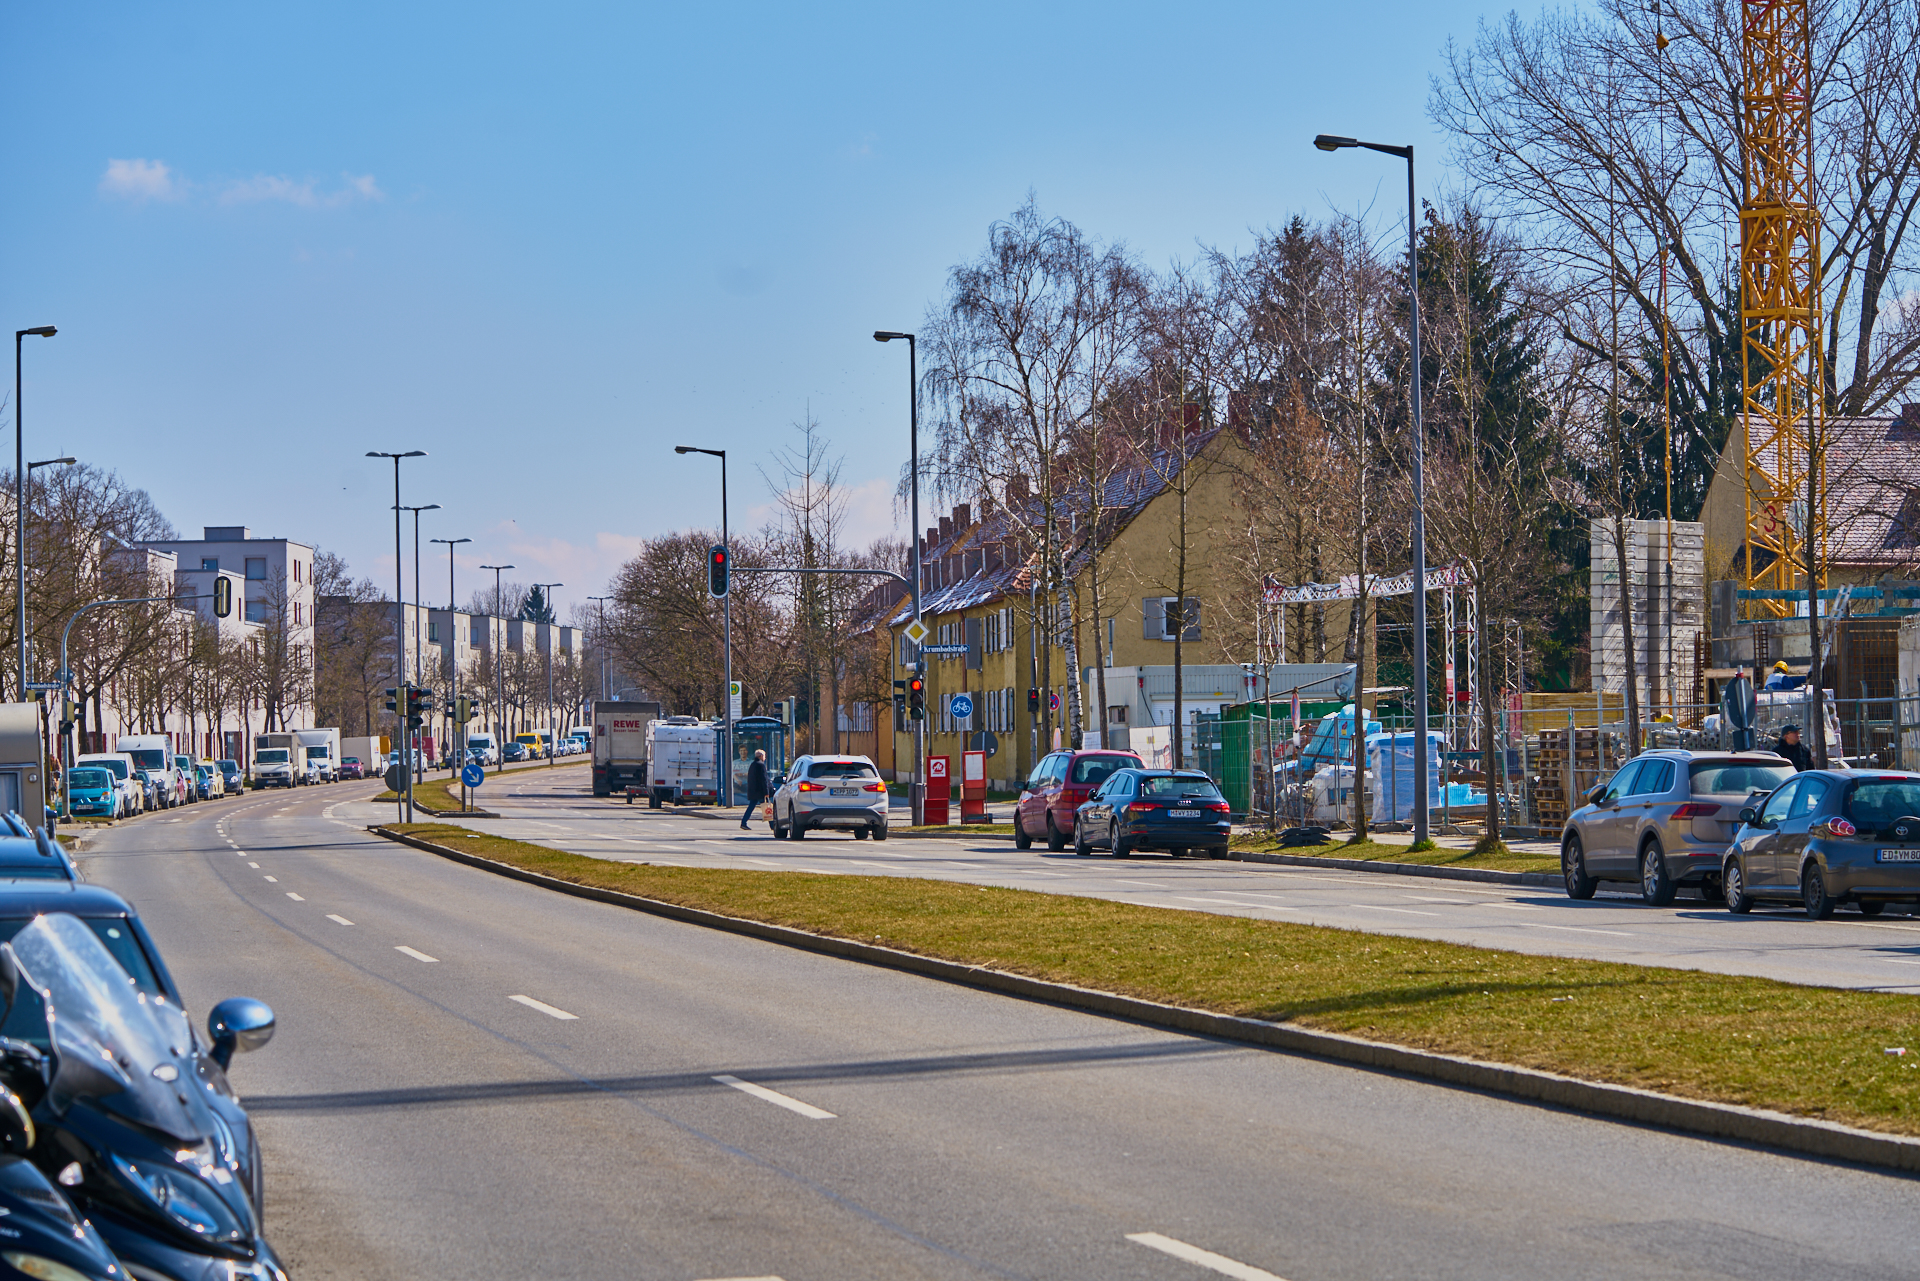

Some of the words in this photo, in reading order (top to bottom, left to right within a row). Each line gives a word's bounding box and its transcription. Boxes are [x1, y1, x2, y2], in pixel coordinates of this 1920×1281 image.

[1764, 505, 1777, 533] 3
[923, 645, 968, 653] Krumbadstraße
[613, 720, 640, 728] REWE
[1882, 850, 1894, 860] ED
[1898, 850, 1910, 860] YM
